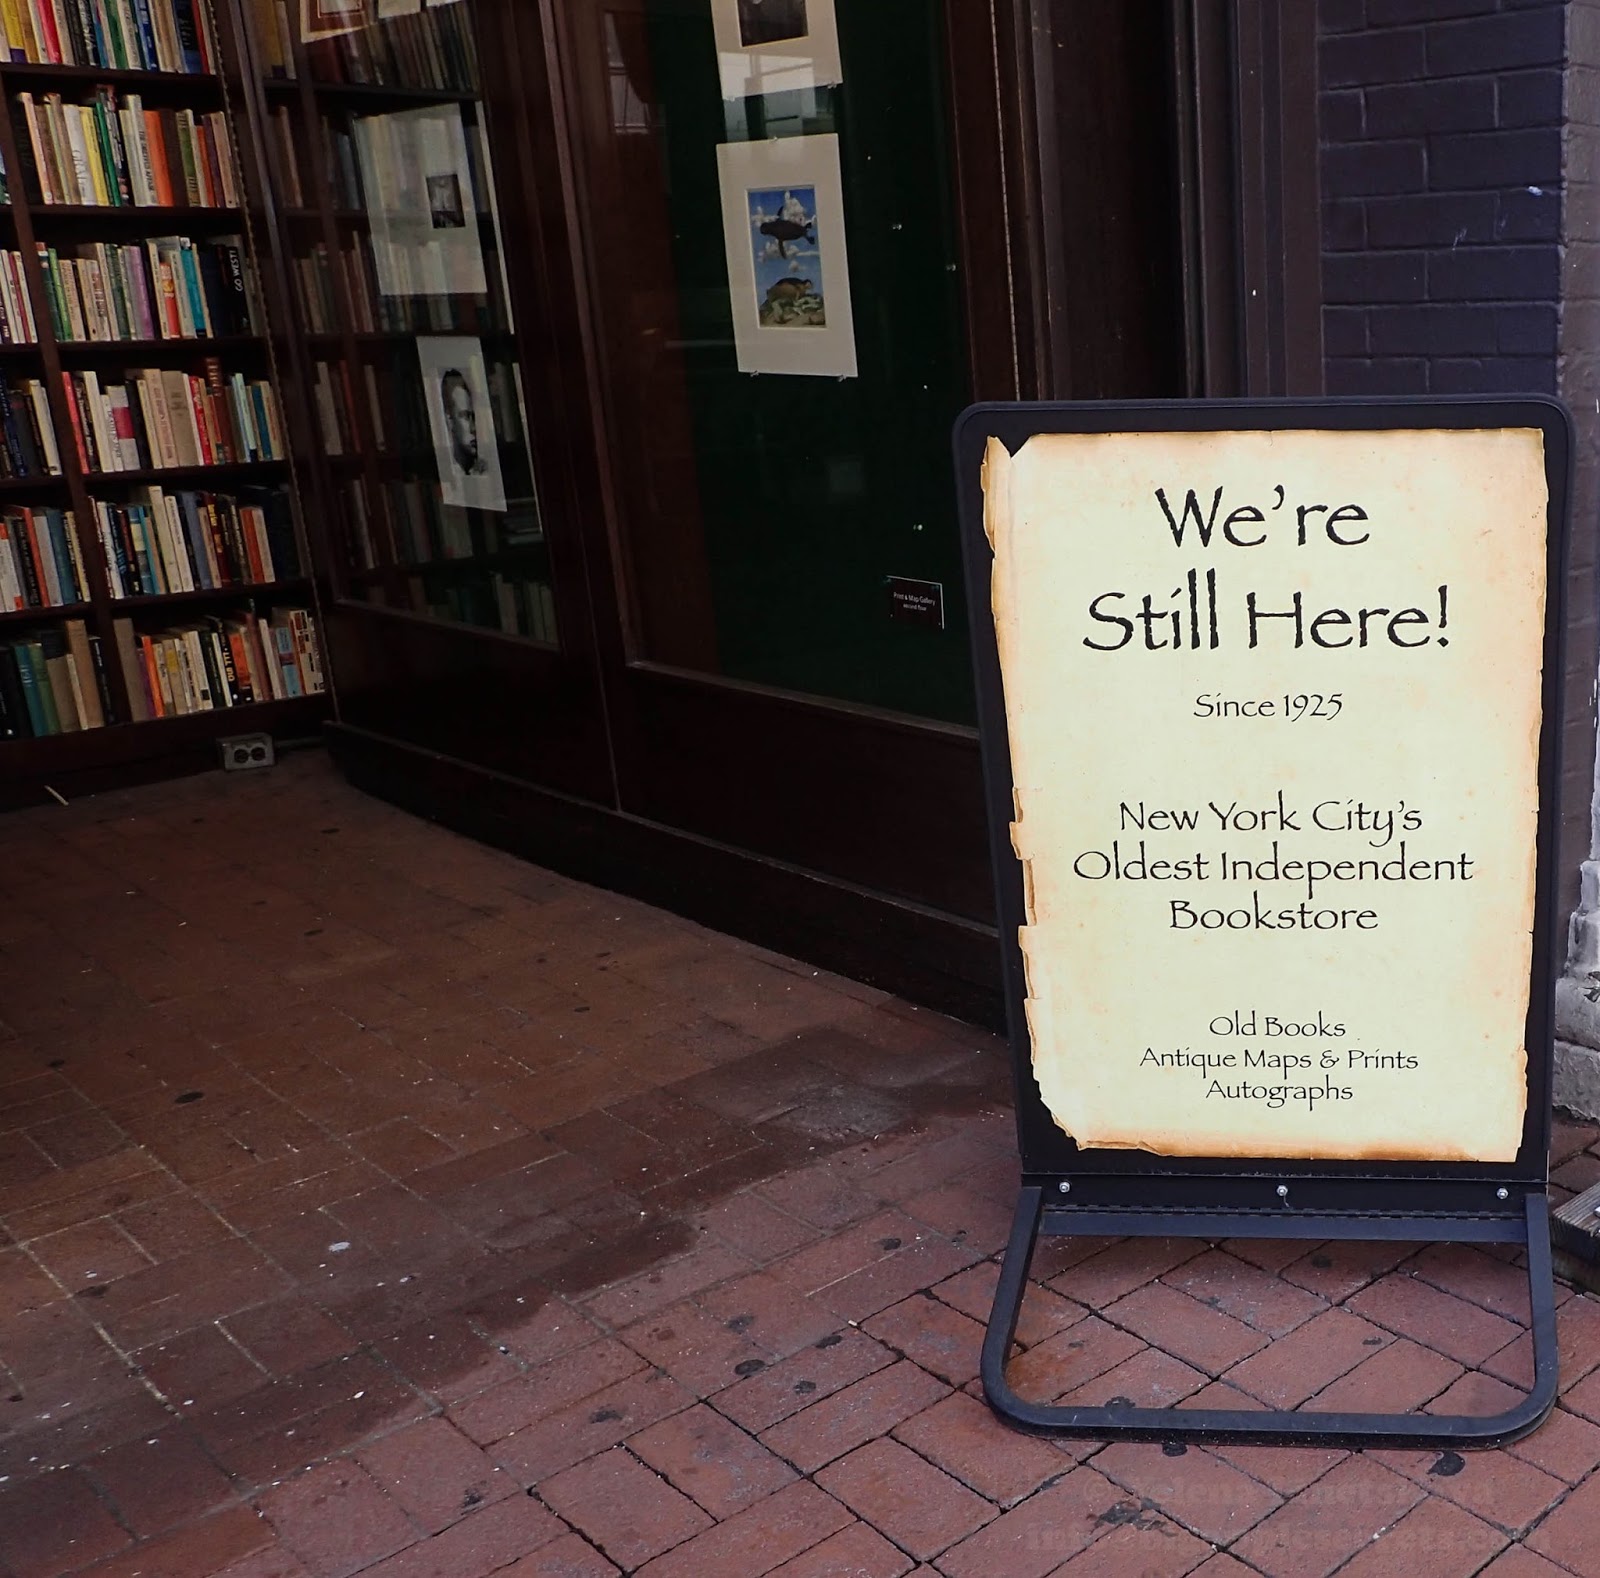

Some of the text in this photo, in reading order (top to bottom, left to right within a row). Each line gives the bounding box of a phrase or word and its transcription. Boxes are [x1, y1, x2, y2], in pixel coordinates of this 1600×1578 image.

[234, 278, 244, 292] GO
[1082, 567, 1449, 651] Still Here!
[1193, 692, 1344, 723] Since 1925
[1119, 801, 1199, 831] New
[1208, 789, 1302, 831] York
[1073, 840, 1475, 901] Oldest Independent
[1169, 889, 1379, 930] Bookstore
[1209, 1009, 1347, 1037] Old Books
[1139, 1045, 1420, 1080] Antique Maps & Prints
[1205, 1073, 1354, 1112] Autographs
